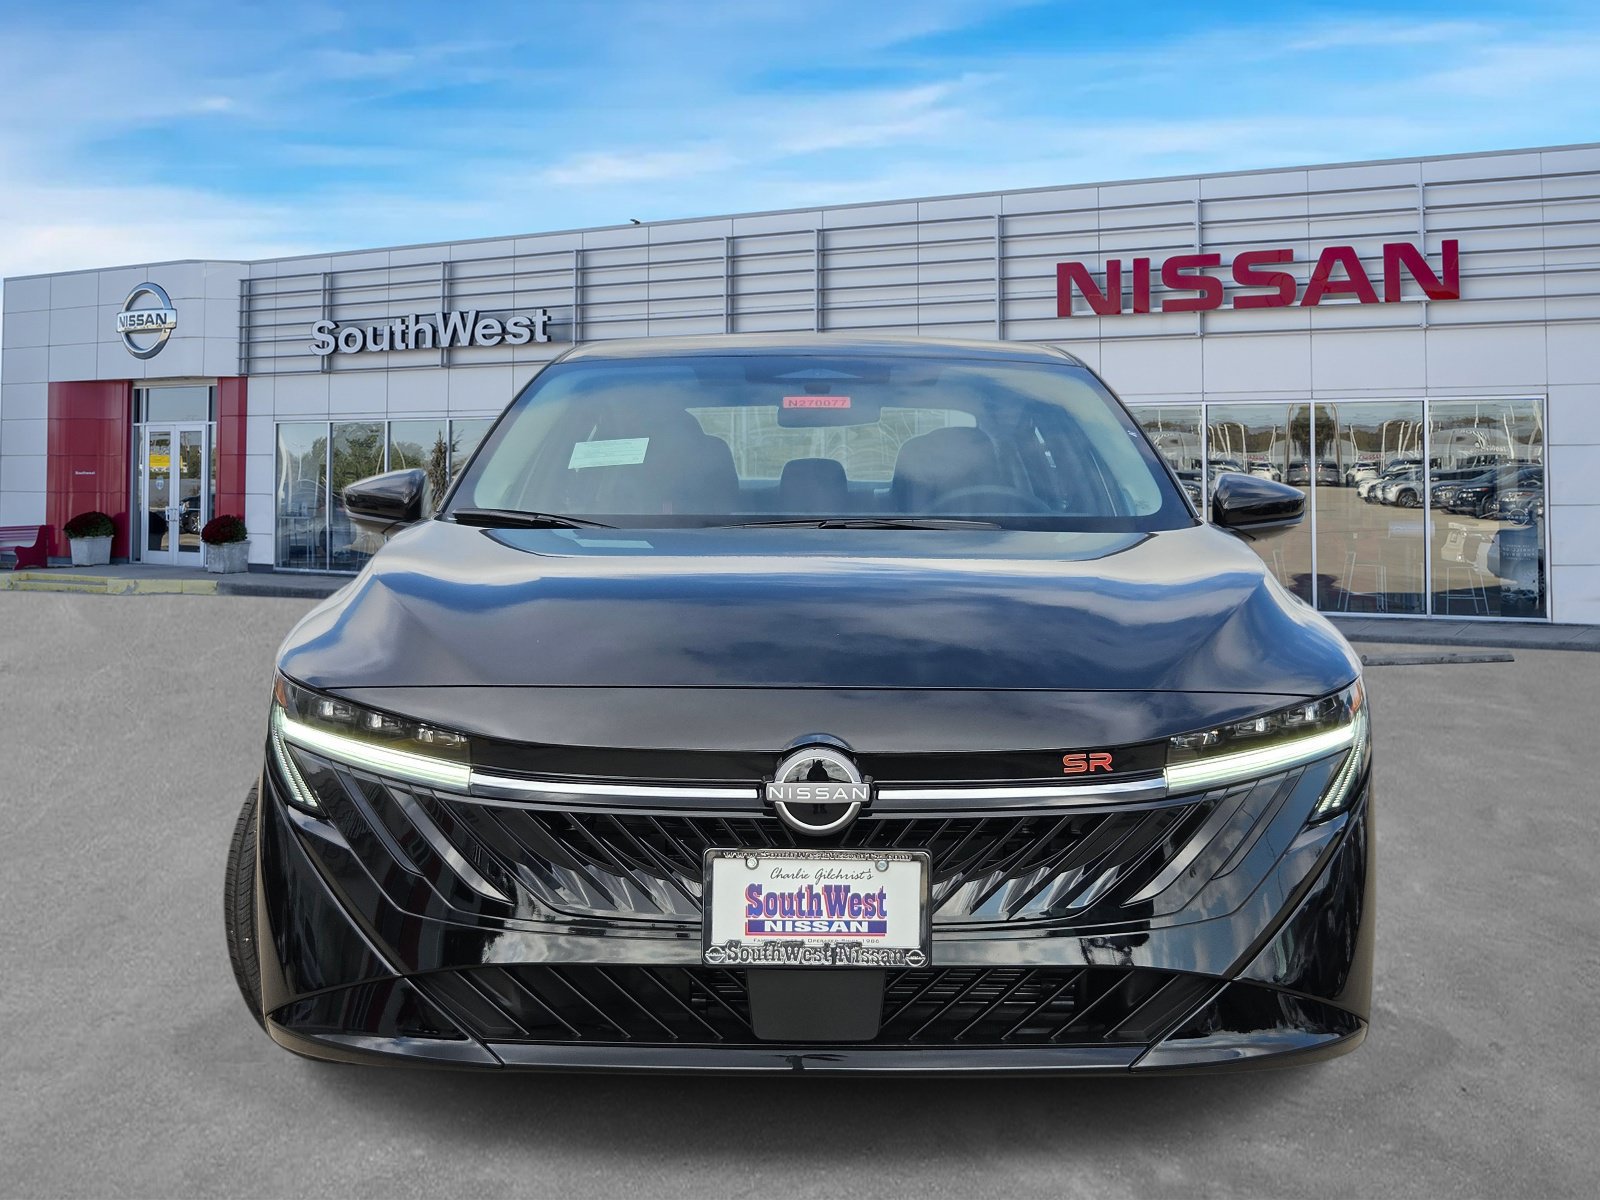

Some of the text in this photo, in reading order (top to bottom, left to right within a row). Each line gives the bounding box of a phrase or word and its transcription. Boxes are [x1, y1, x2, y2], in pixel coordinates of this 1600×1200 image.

[1056, 239, 1461, 318] NISSAN
[119, 312, 167, 328] NISSAN
[307, 308, 552, 356] SouthWest
[788, 399, 847, 407] N270077
[1062, 752, 1114, 773] SR
[768, 786, 867, 800] NISSAN
[770, 867, 874, 885] Charlie Gilchrist's
[745, 883, 887, 919] SouthWest
[764, 920, 869, 933] NISSAN
[835, 942, 906, 966] Nissan
